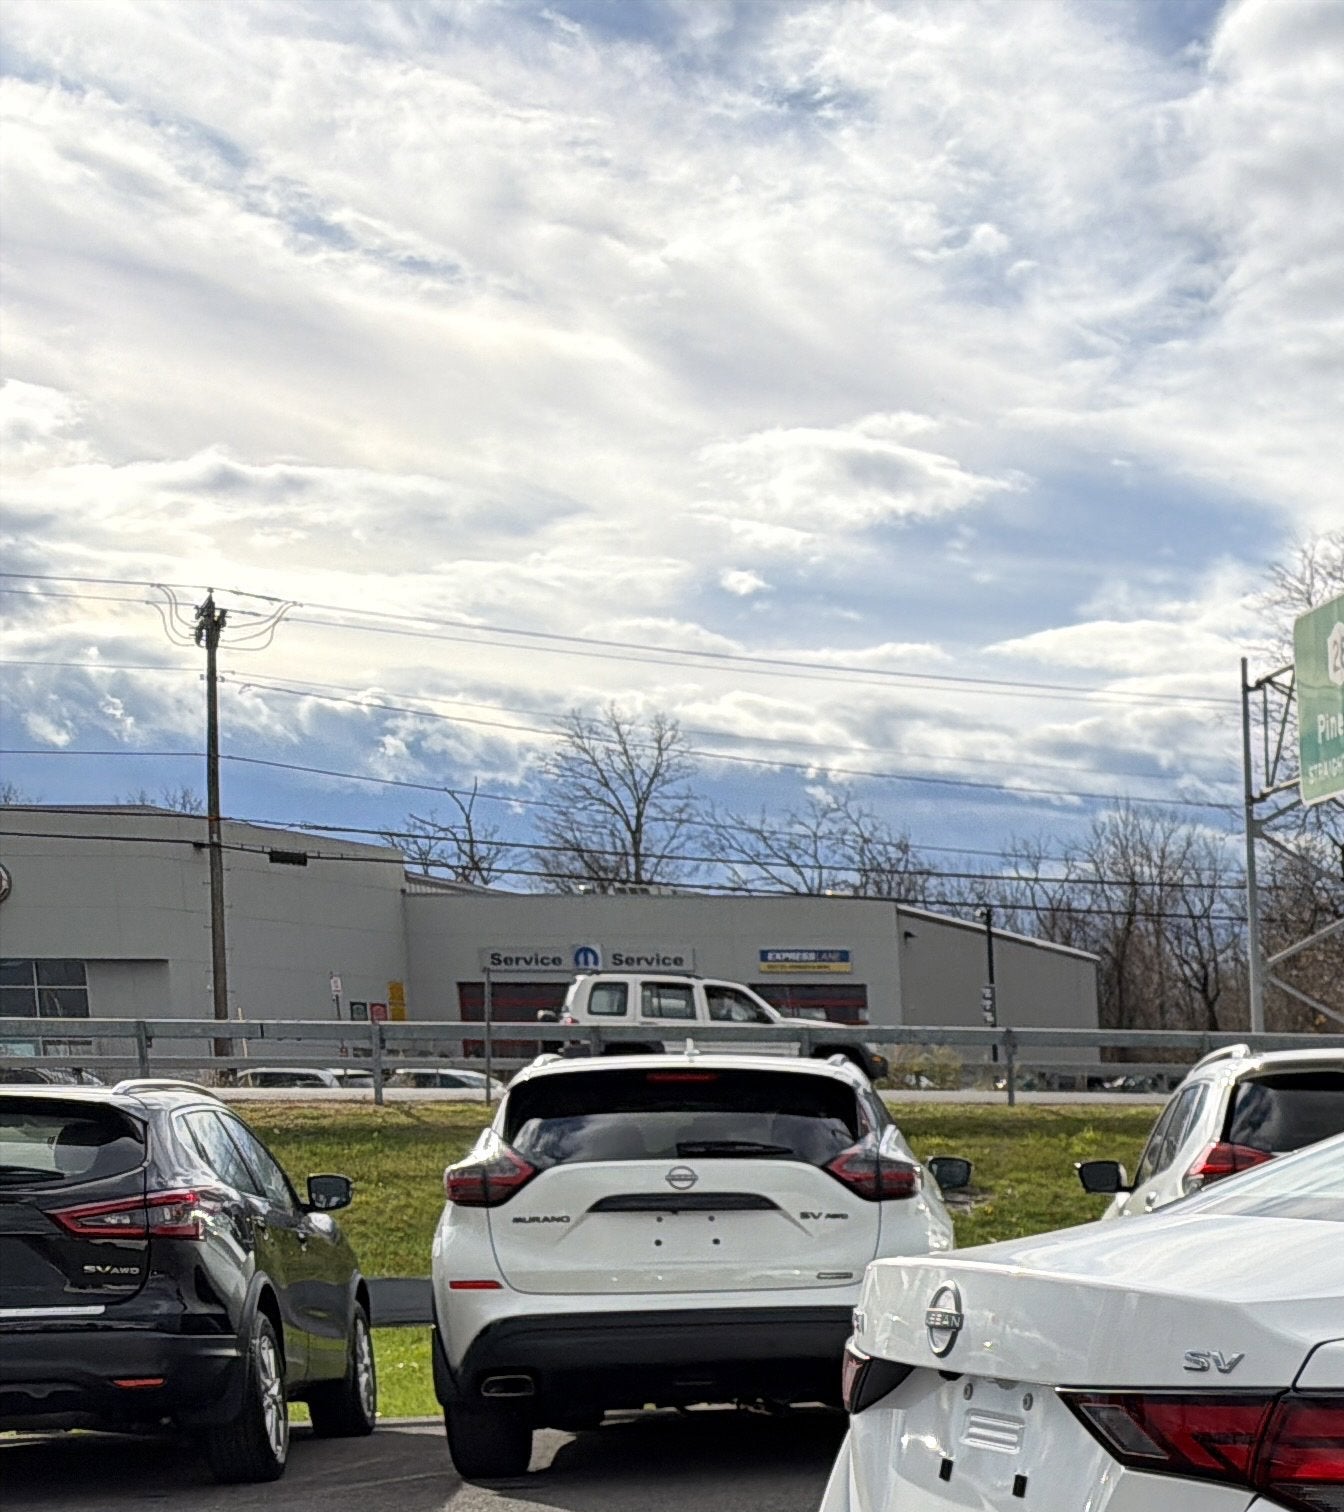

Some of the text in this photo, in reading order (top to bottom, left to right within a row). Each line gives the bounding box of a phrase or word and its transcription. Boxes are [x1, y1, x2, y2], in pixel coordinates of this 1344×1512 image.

[1317, 712, 1344, 745] Pine
[490, 953, 685, 967] Service Service
[512, 1215, 571, 1224] MURANO
[800, 1211, 823, 1220] SV
[83, 1265, 140, 1275] SV AWD
[1183, 1350, 1245, 1374] SV
